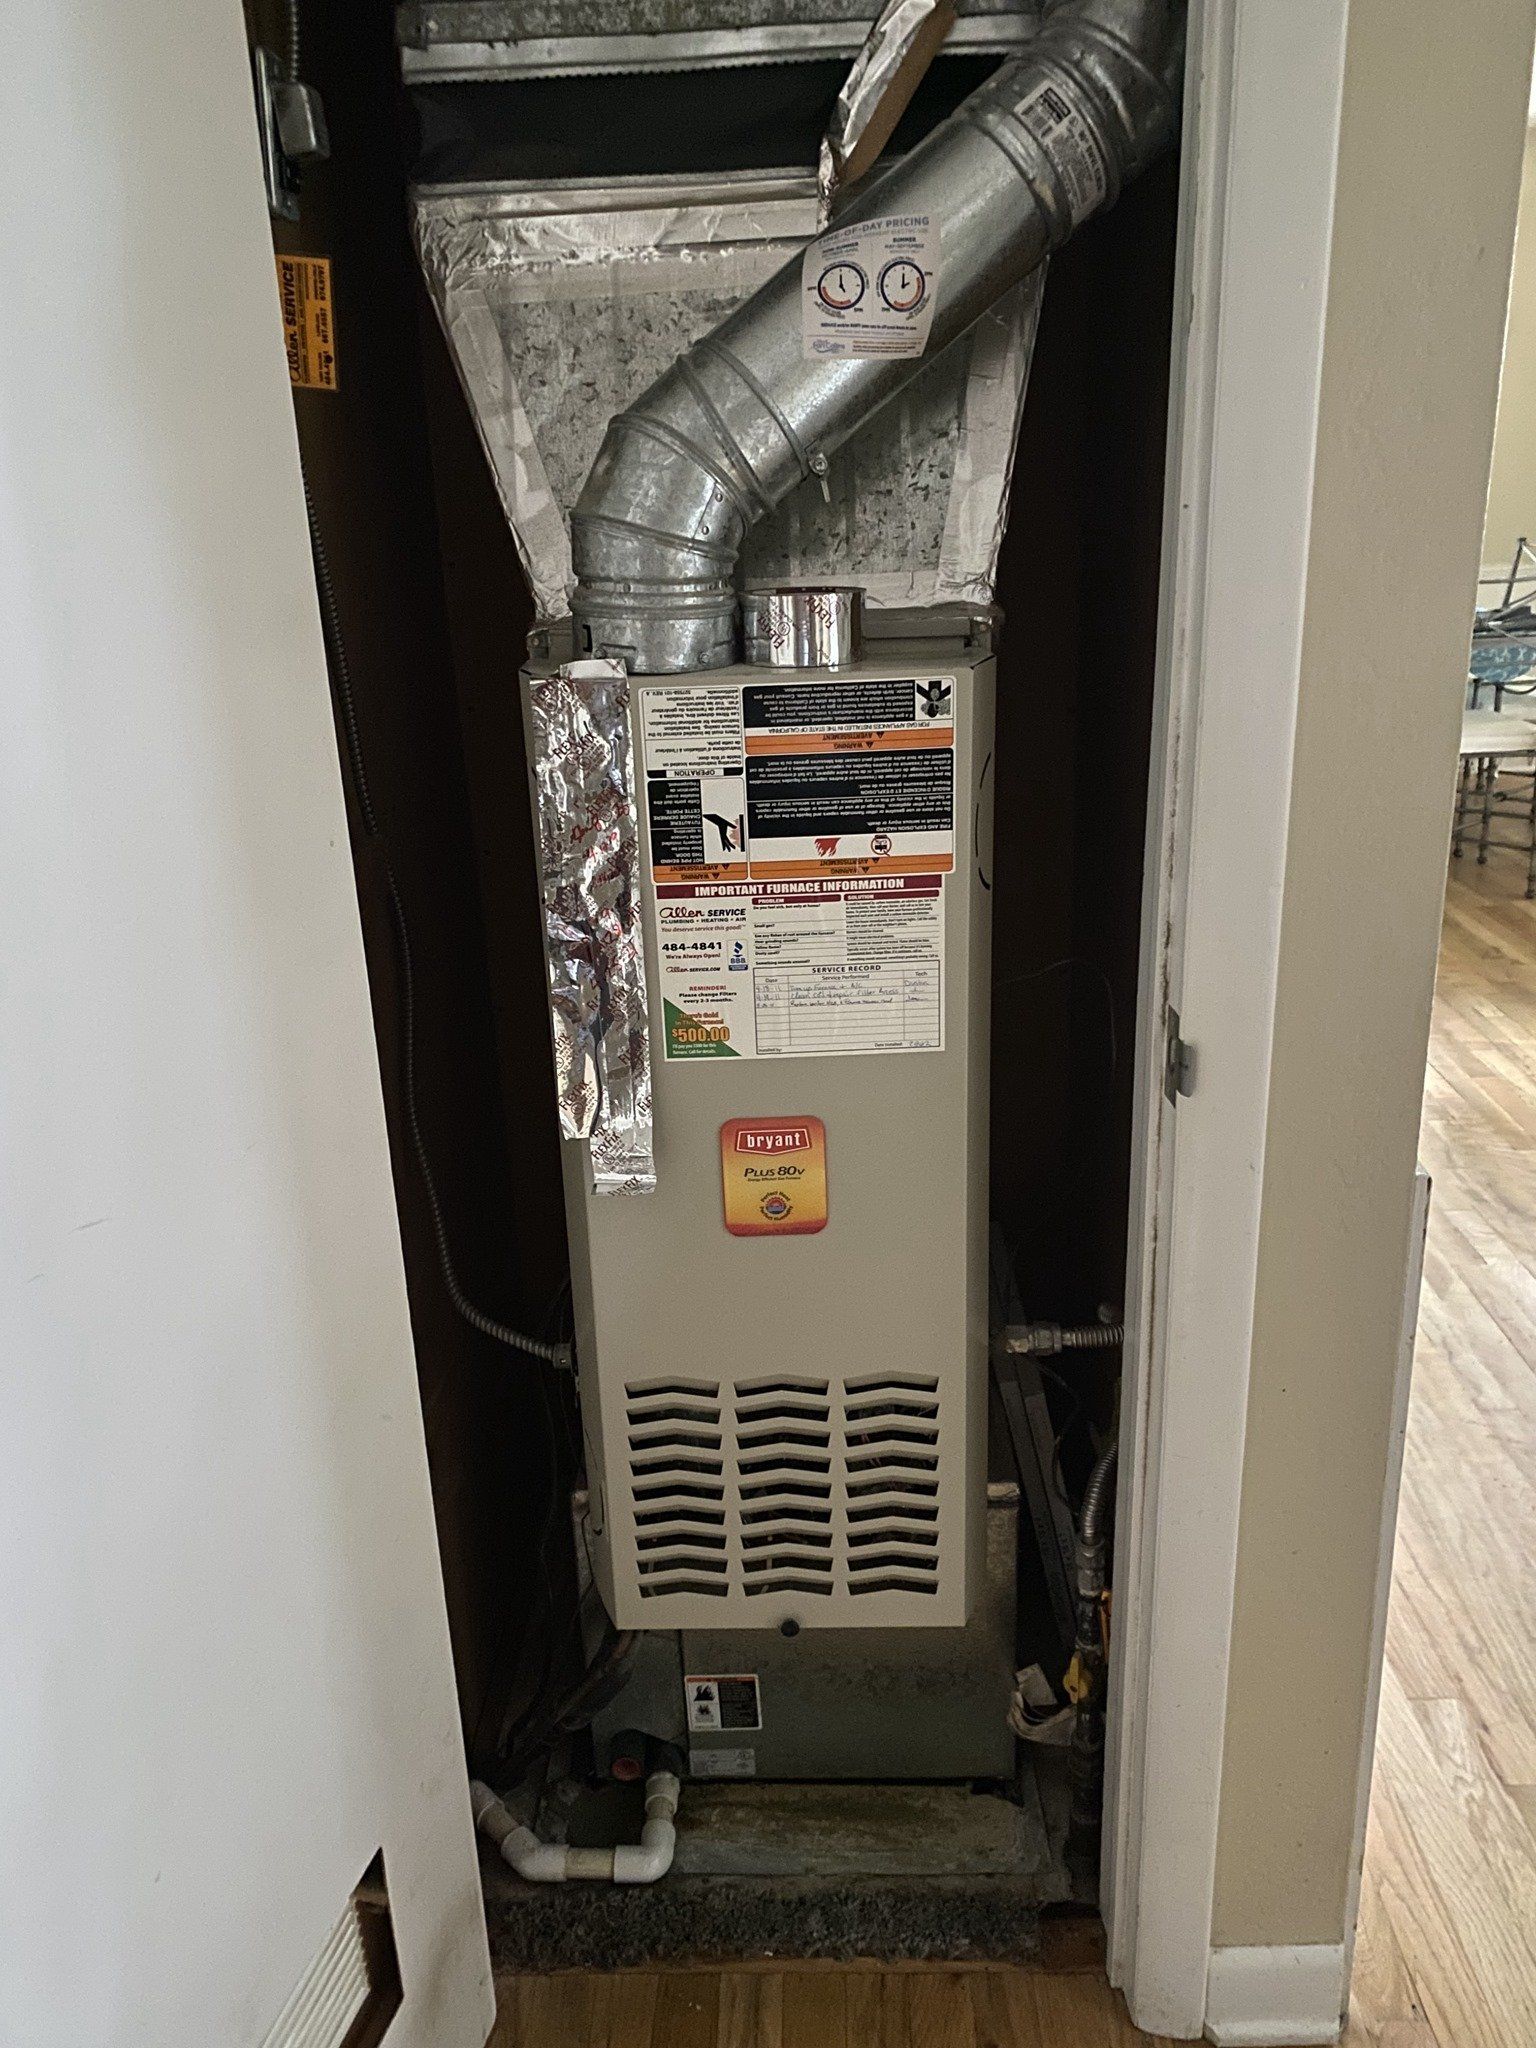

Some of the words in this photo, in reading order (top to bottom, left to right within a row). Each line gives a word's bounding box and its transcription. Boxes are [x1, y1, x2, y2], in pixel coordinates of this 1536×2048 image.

[886, 216, 929, 228] PRICING
[282, 262, 297, 326] SERVICE
[694, 883, 764, 897] IMPORTANT
[766, 881, 820, 894] FURNACE
[823, 877, 904, 892] INFORMATION
[660, 906, 705, 918] Allen
[708, 908, 746, 917] SERVICE
[662, 942, 722, 951] 484-4841
[672, 1026, 730, 1043] $500.00
[559, 1080, 590, 1111] FLEXFIX
[591, 1131, 621, 1160] FLEXFIX
[747, 1132, 801, 1149] bryant
[608, 1175, 641, 1197] FLEXFIX
